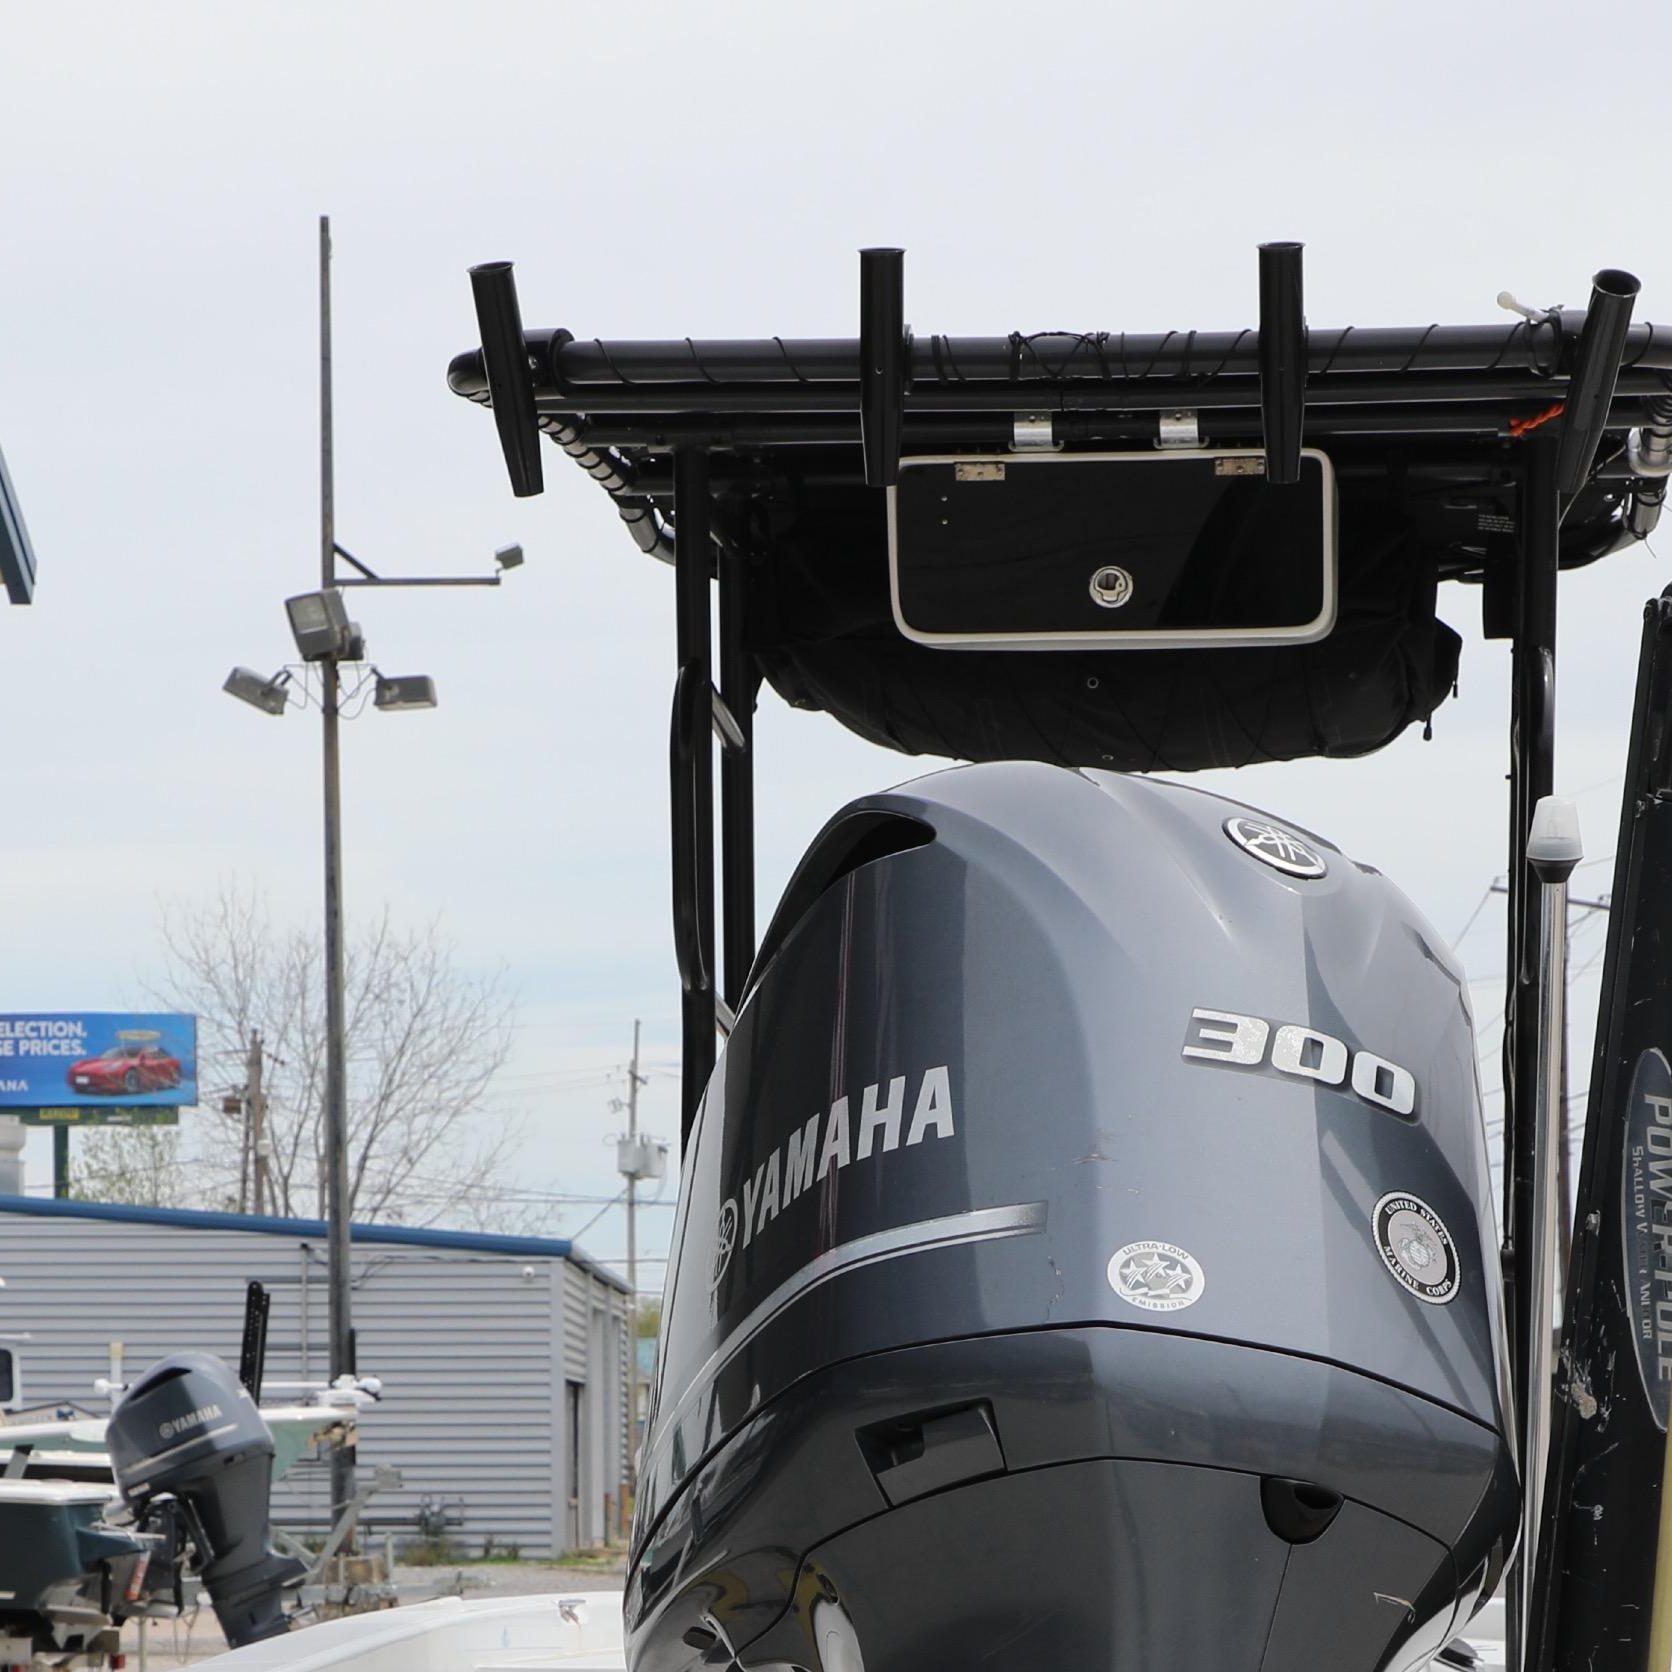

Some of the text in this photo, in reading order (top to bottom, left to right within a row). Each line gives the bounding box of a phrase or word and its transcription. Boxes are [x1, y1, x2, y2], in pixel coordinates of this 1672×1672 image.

[18, 1039, 87, 1056] PRICES.
[1182, 1007, 1416, 1115] 300
[742, 1065, 955, 1250] YAMAHA
[1384, 1199, 1449, 1246] UNITED STATES
[1384, 1245, 1452, 1296] MARINE CORPS
[1131, 1296, 1185, 1309] EMISSION
[171, 1404, 224, 1433] YAMAHA
